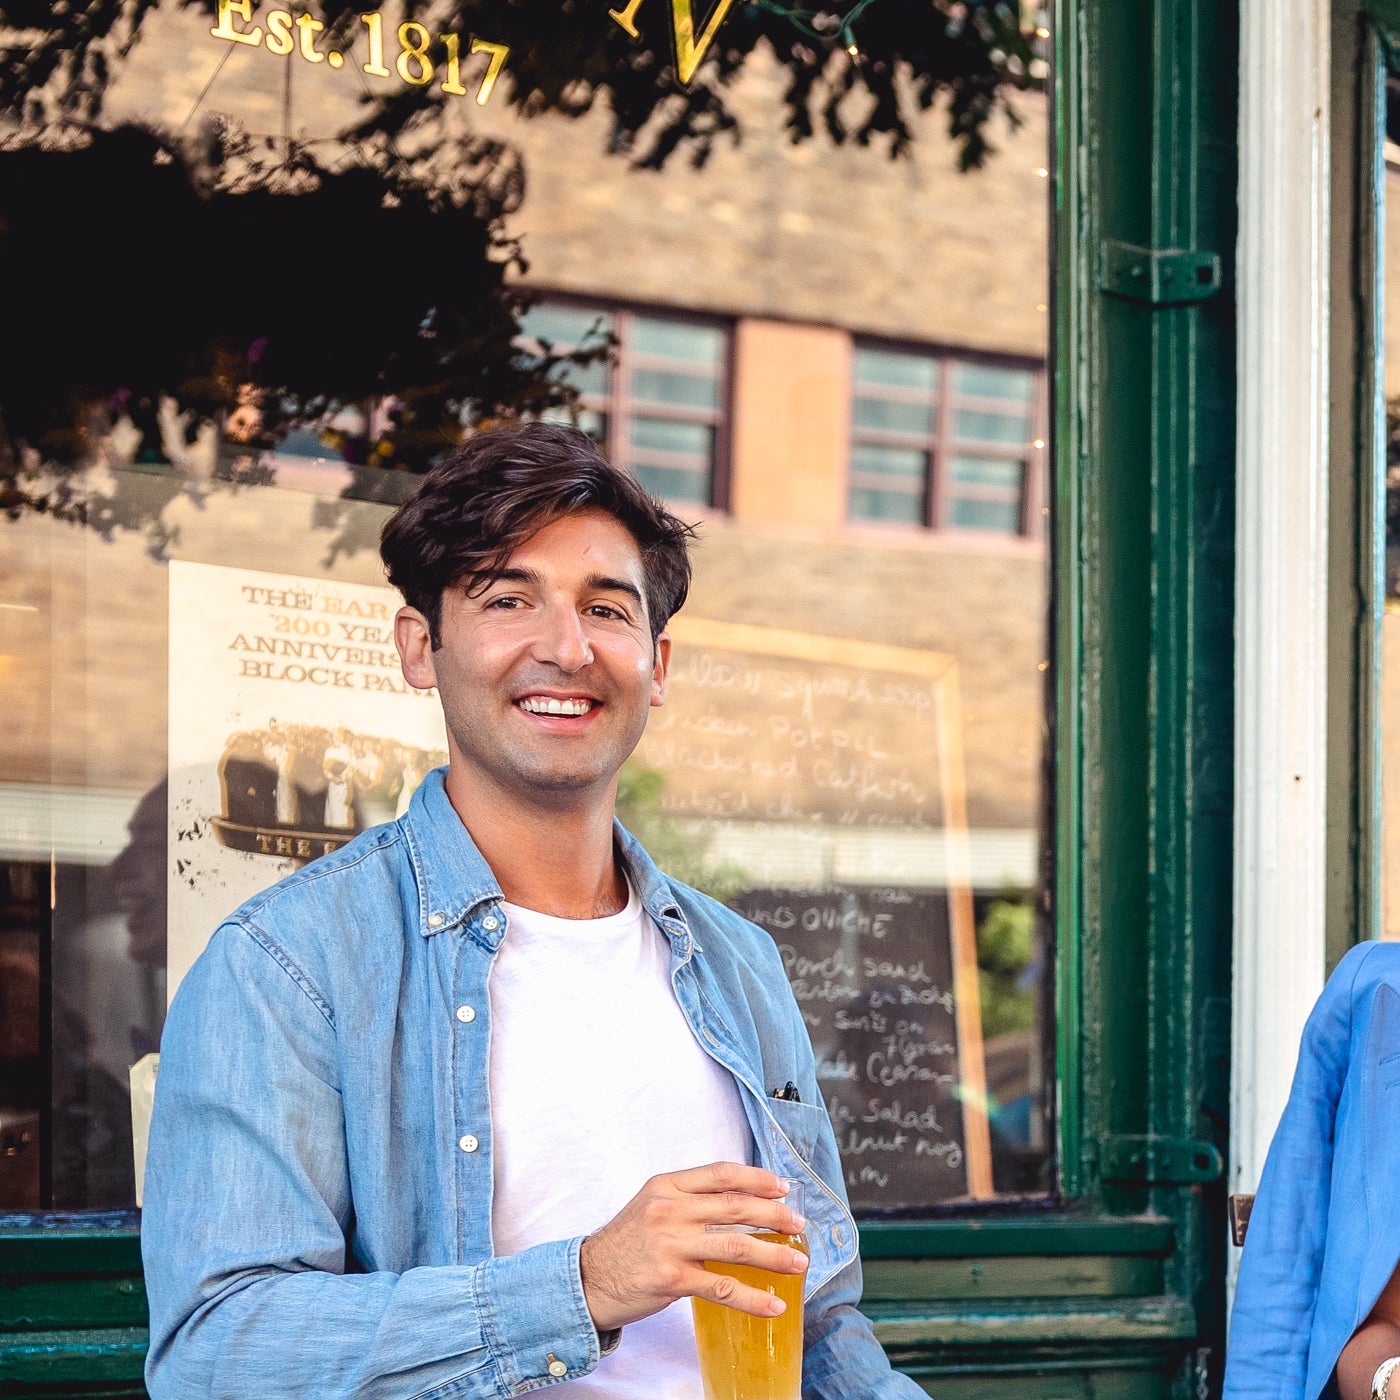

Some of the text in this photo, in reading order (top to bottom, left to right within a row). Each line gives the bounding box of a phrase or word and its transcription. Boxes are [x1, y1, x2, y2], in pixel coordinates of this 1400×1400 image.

[210, 0, 344, 69] Est.
[360, 11, 511, 106] 1817
[241, 585, 390, 622] THE EAR
[239, 657, 355, 690] BLOCK
